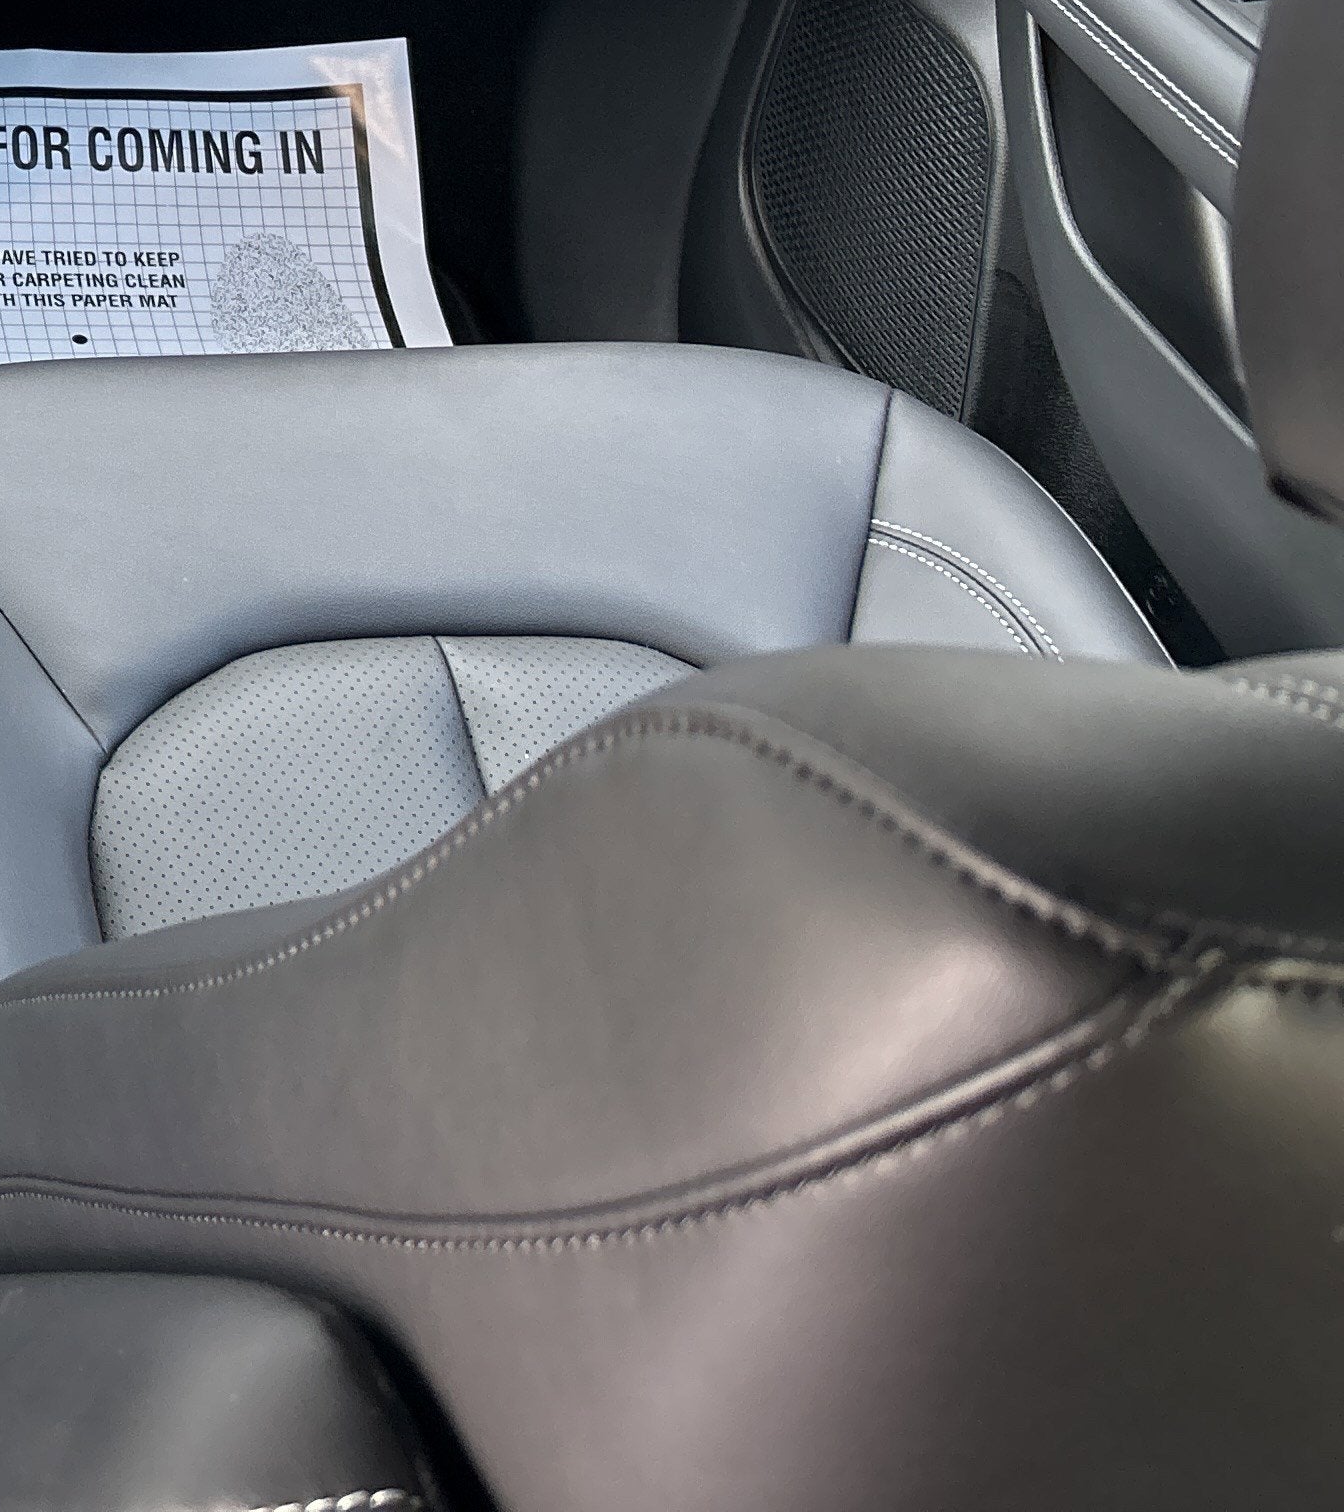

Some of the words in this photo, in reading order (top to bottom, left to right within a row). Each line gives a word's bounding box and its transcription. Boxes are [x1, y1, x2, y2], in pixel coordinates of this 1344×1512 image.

[87, 125, 264, 176] COMING
[279, 128, 325, 175] IN
[41, 250, 97, 267] TRIED
[102, 250, 128, 268] TO
[133, 251, 181, 268] KEEP
[12, 271, 119, 289] CARPETING
[124, 273, 186, 289] CLEAN
[20, 293, 66, 308] THIS
[70, 293, 134, 309] PAPER
[139, 294, 179, 309] MAT
